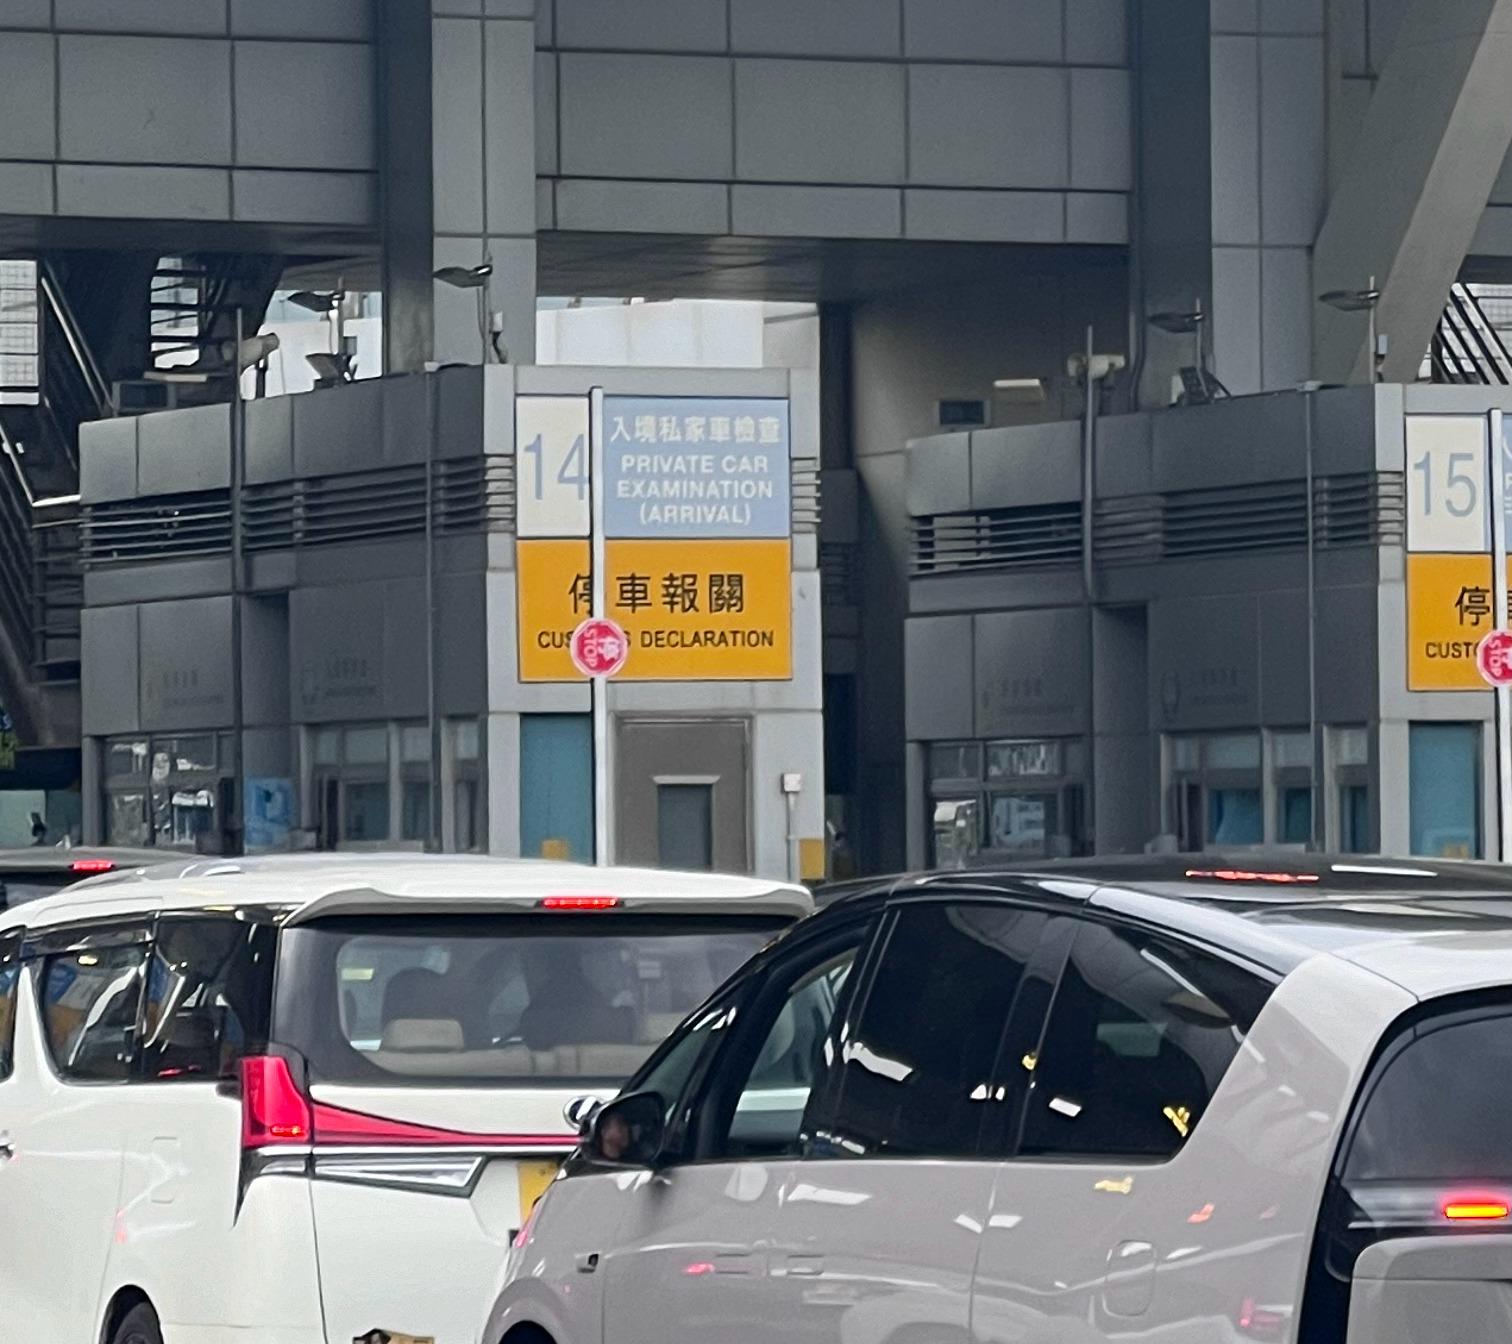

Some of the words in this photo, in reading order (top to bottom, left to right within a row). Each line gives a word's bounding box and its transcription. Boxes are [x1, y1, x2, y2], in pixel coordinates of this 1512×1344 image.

[524, 433, 589, 500] 14
[621, 455, 714, 473] PRIVATE
[721, 455, 769, 474] CAR
[616, 479, 773, 499] EXAMINATION
[1413, 450, 1477, 518] 15
[639, 502, 752, 525] (ARRIVAL)
[640, 630, 774, 648] DECLARATION
